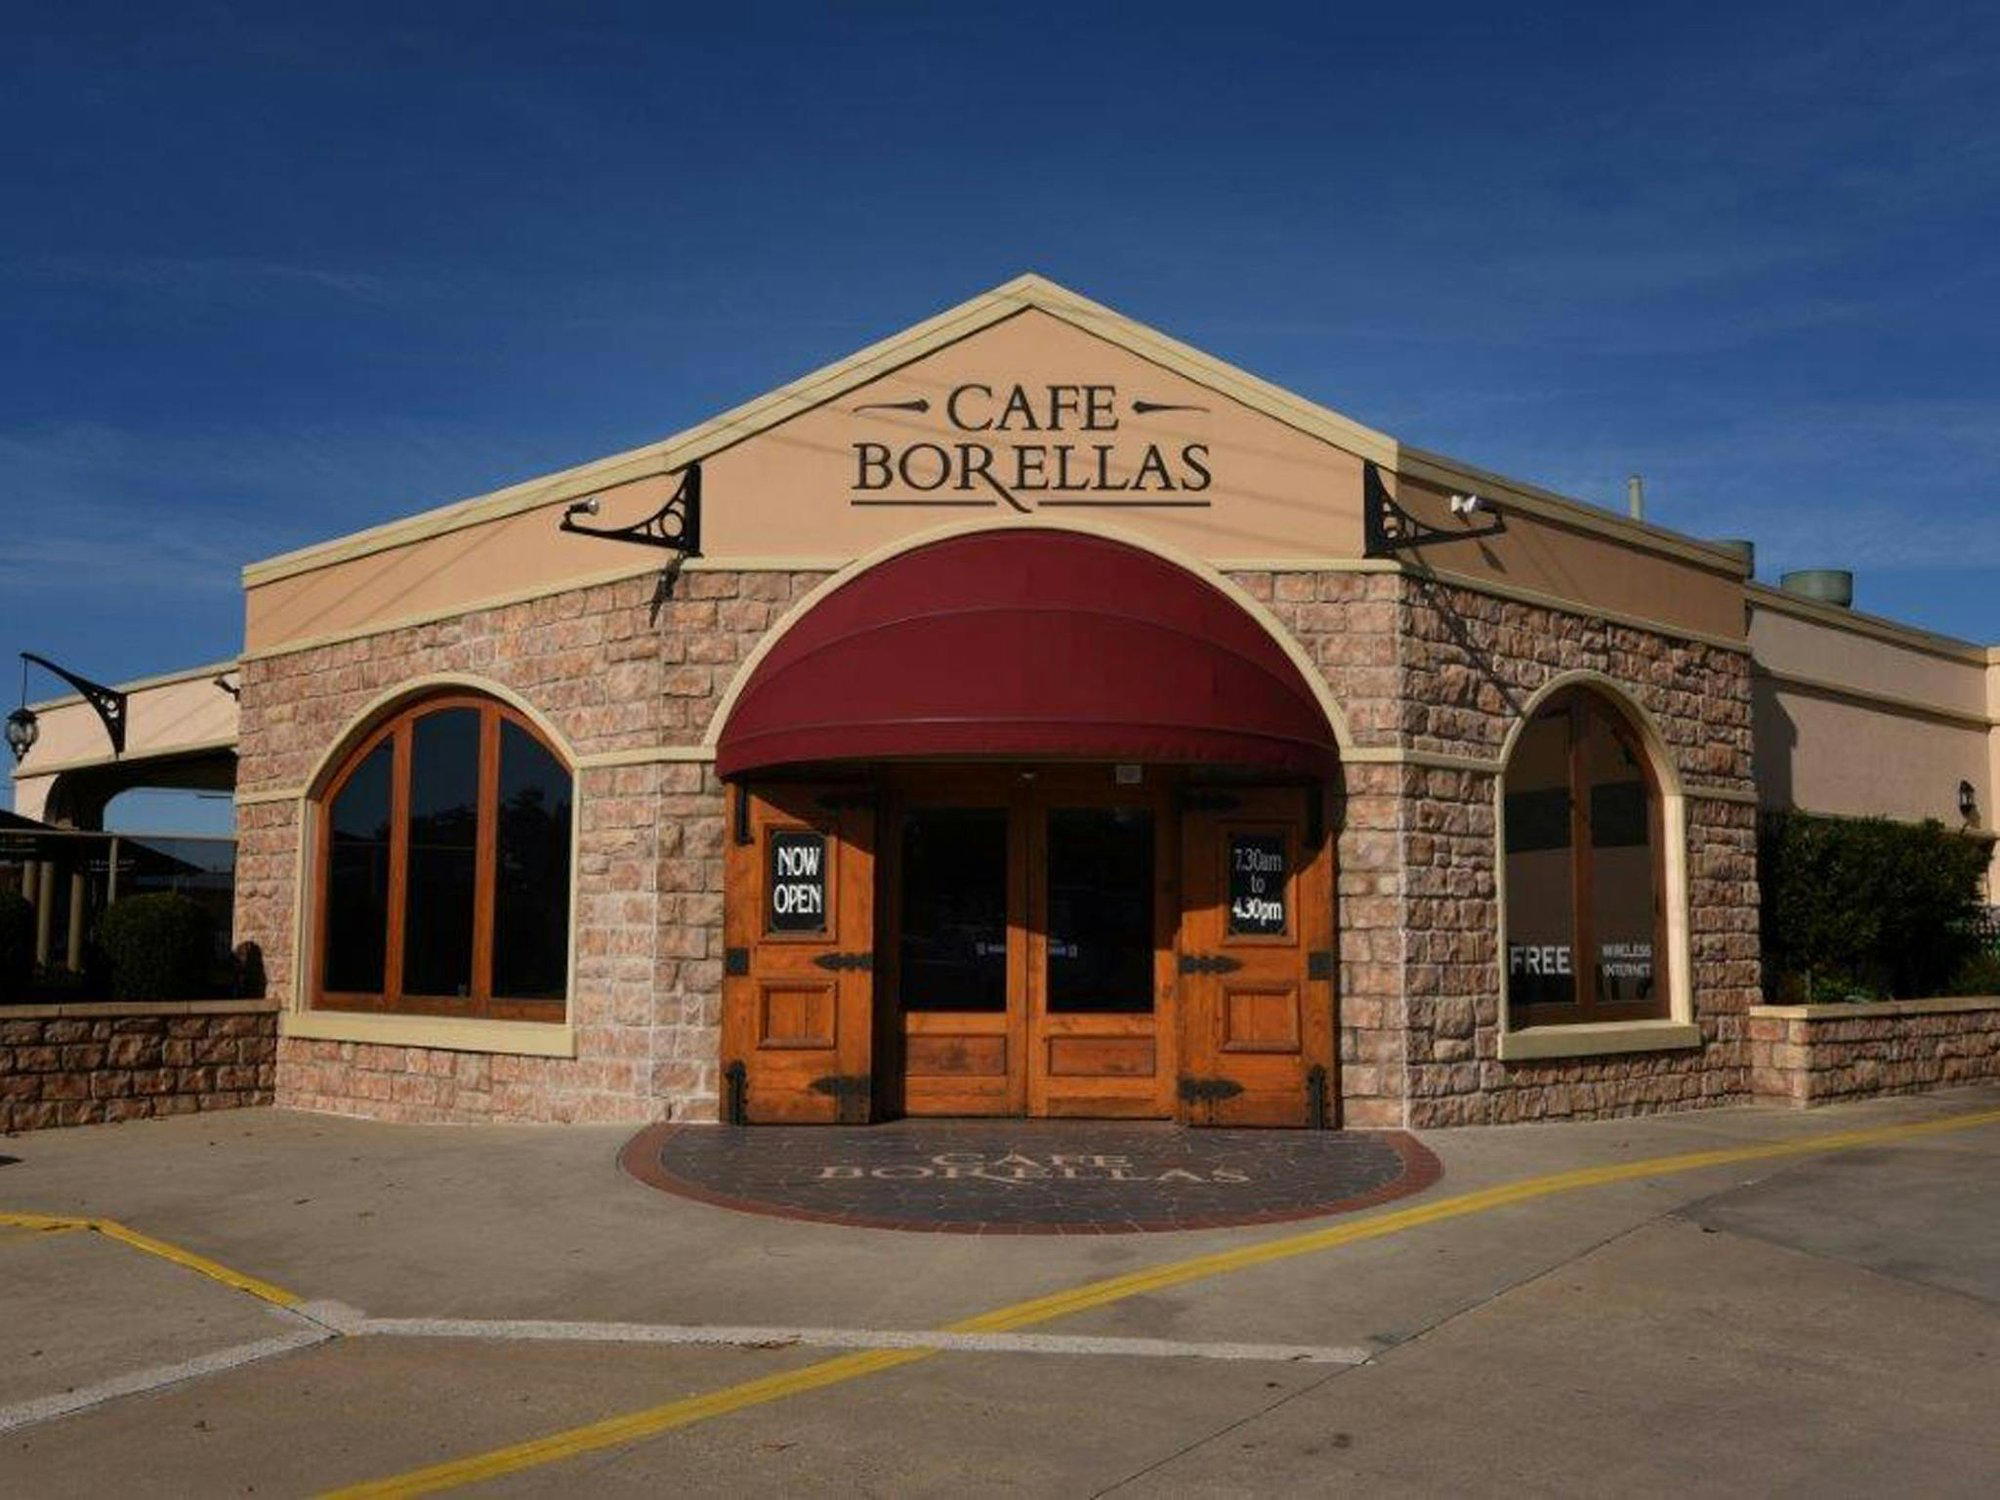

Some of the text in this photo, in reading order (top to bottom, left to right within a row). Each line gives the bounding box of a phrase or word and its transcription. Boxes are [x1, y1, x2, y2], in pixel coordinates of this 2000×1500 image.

[947, 383, 1120, 432] CAFE
[850, 442, 1213, 514] BORELLAS
[778, 846, 820, 876] NOW
[773, 883, 823, 914] OPEN
[1250, 874, 1267, 894] to
[1510, 945, 1572, 976] FREE
[1601, 943, 1653, 959] WIRELESS
[931, 1152, 1136, 1168] CAFE
